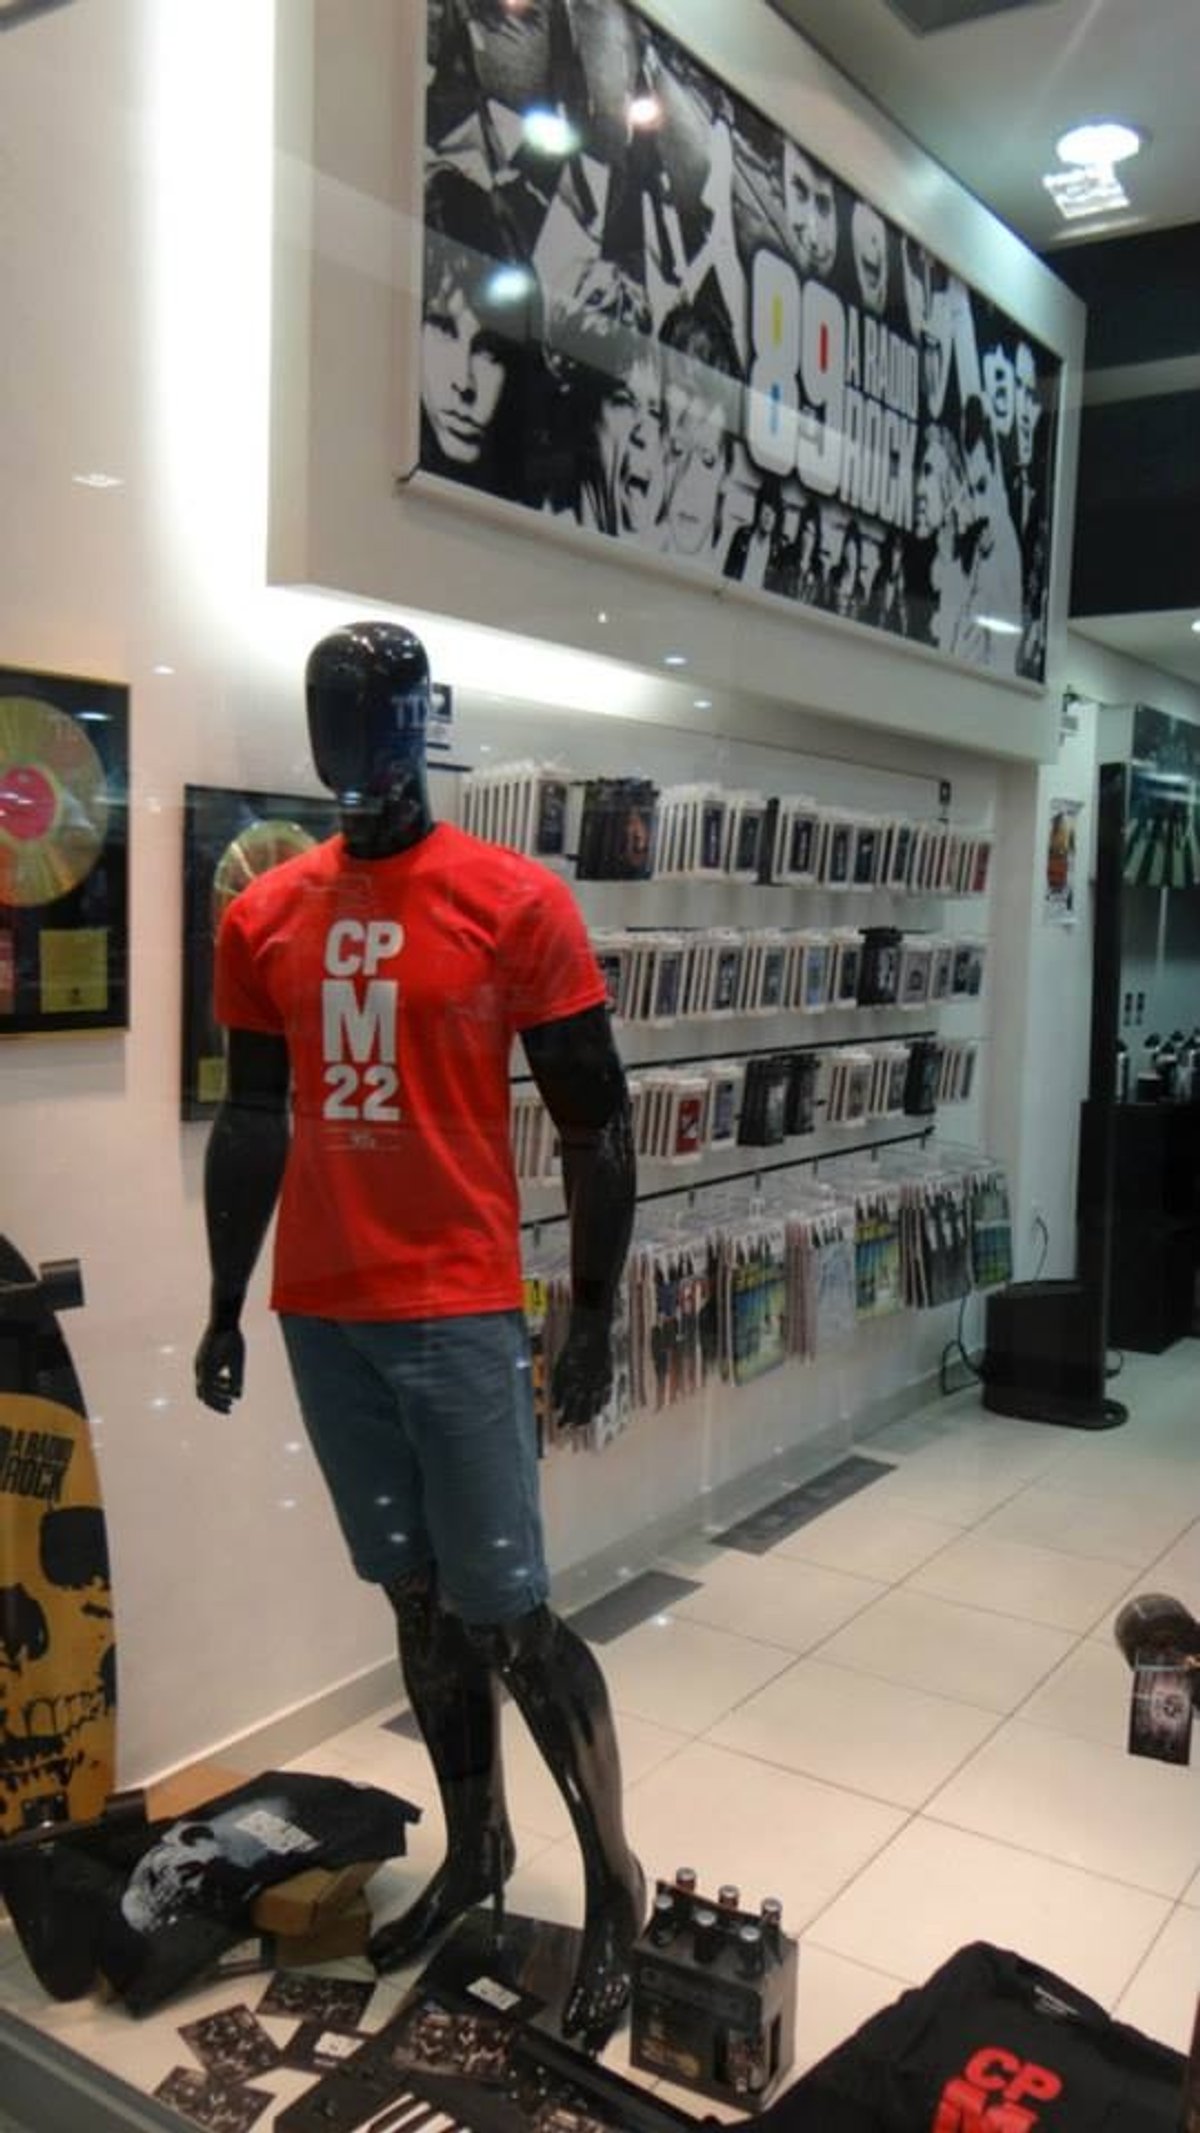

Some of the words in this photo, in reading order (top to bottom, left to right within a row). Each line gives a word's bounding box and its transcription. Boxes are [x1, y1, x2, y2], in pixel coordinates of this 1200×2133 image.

[745, 248, 846, 496] 89
[845, 303, 861, 385] A
[863, 313, 919, 421] RADIO
[840, 386, 919, 531] ROCK
[324, 919, 405, 977] CP
[321, 979, 398, 1063] M
[322, 1064, 400, 1121] 22
[965, 2047, 1062, 2101] CP
